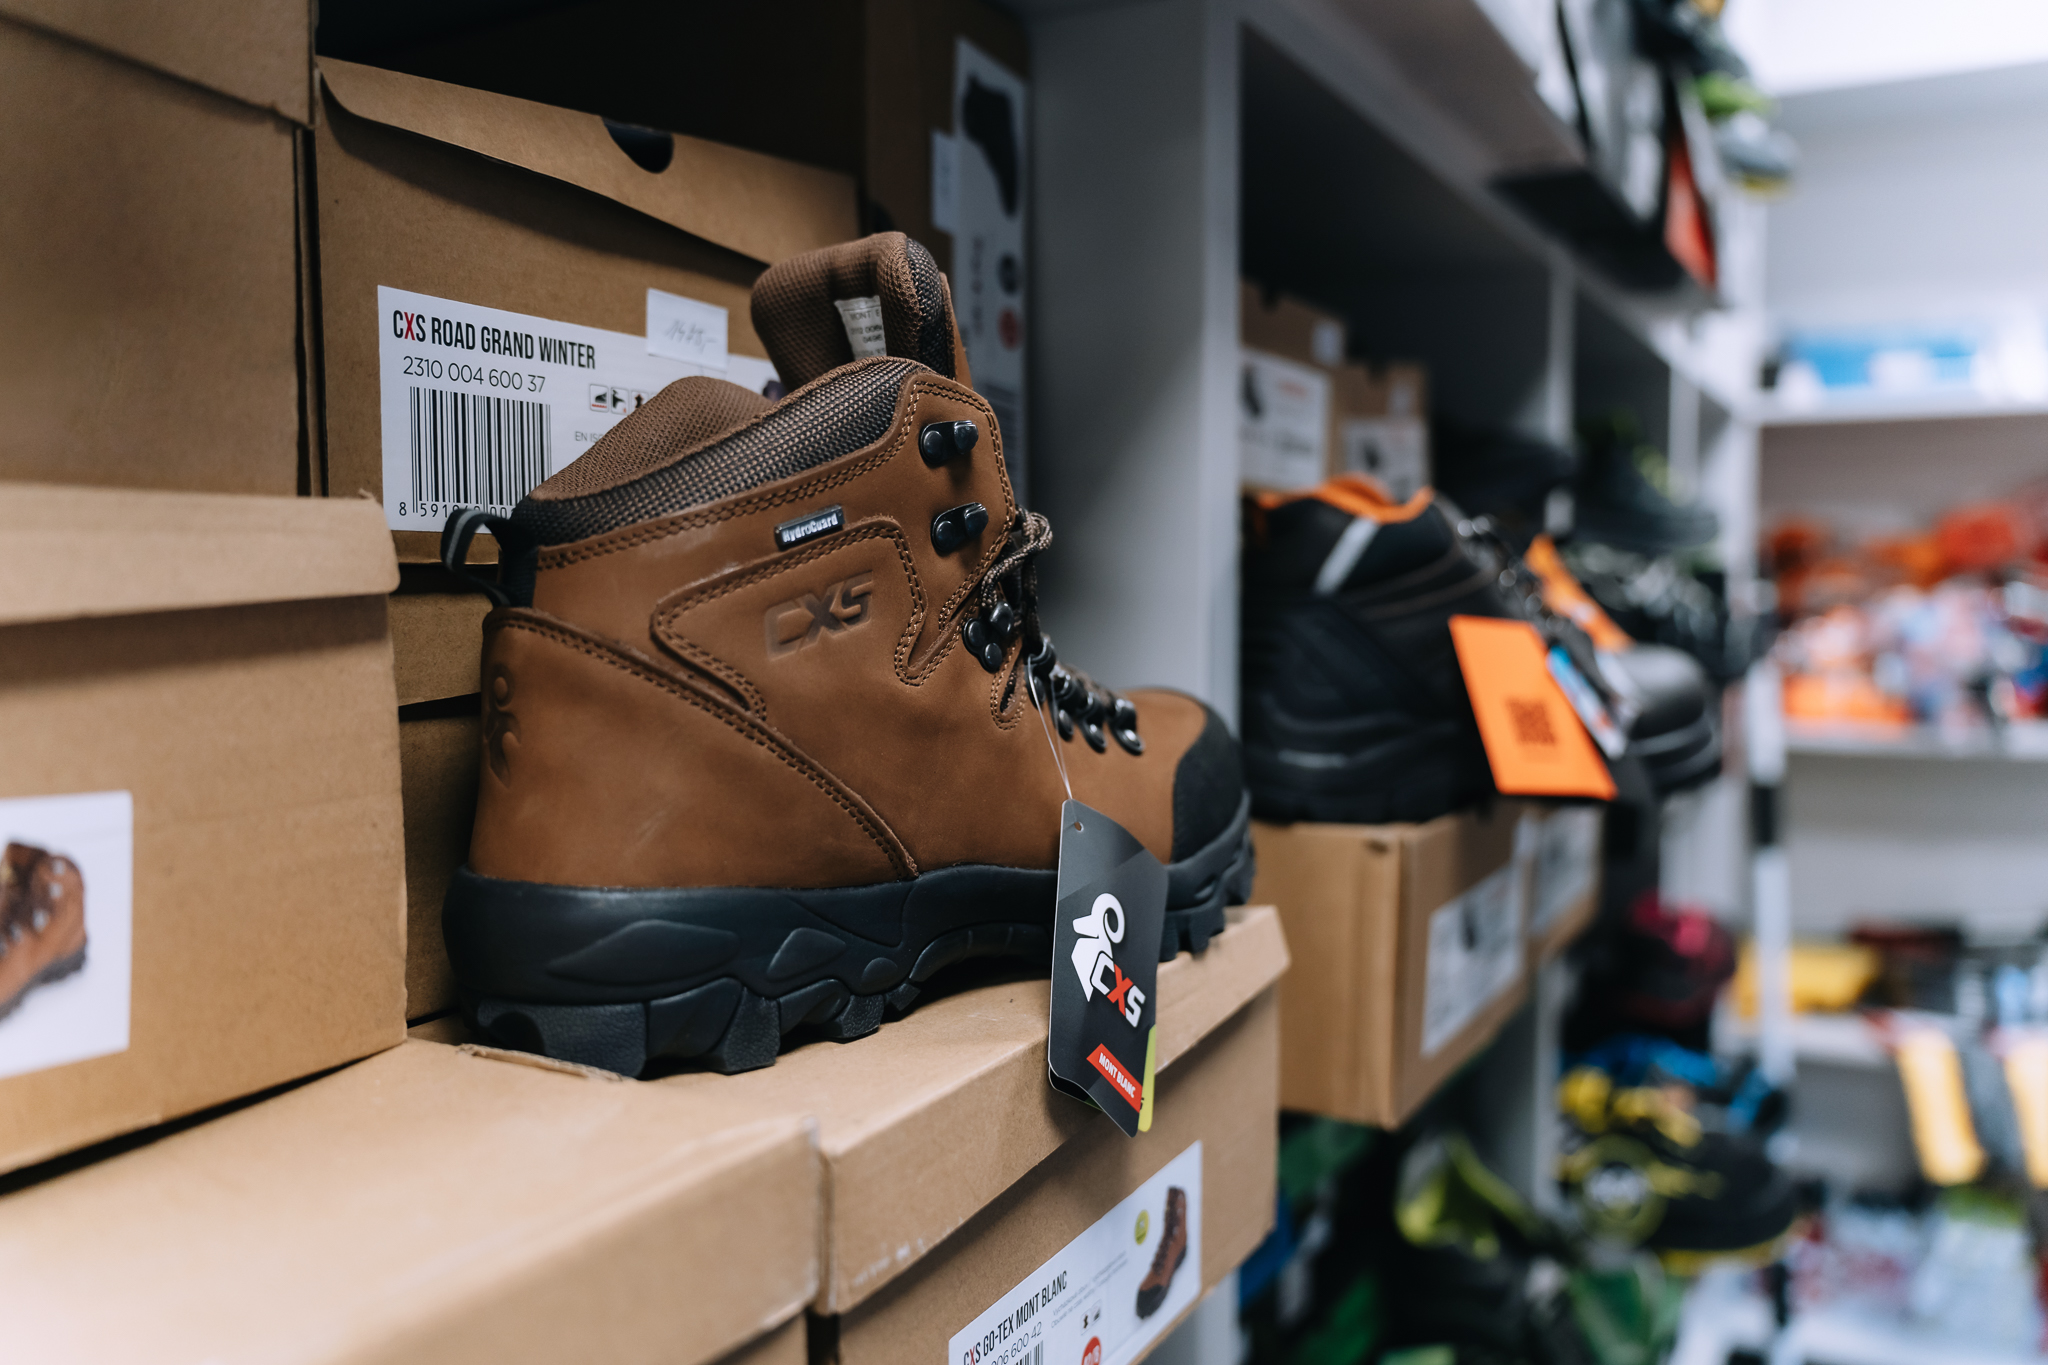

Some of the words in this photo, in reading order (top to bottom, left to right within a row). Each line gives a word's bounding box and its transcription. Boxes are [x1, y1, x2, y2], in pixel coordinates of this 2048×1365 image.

[393, 310, 426, 343] CXS
[431, 316, 476, 351] ROAD
[481, 326, 535, 360] GRAND
[538, 336, 596, 370] WINTER
[403, 355, 443, 379] 2310
[448, 362, 485, 385] 004
[489, 368, 523, 391] 600
[527, 373, 546, 393] 37
[575, 431, 588, 442] EN
[399, 501, 407, 517] 8
[782, 513, 839, 543] HydroGuard
[764, 570, 875, 662] CXS
[1090, 951, 1146, 1028] CXS
[1099, 1052, 1118, 1079] MONT
[1116, 1070, 1136, 1099] BLANC
[963, 1342, 981, 1365] CXS
[983, 1313, 1014, 1357] GO-TEX
[1016, 1292, 1040, 1330] MONT
[1042, 1270, 1067, 1308] BLANC
[1011, 1332, 1030, 1358] 600
[1031, 1321, 1043, 1339] 42
